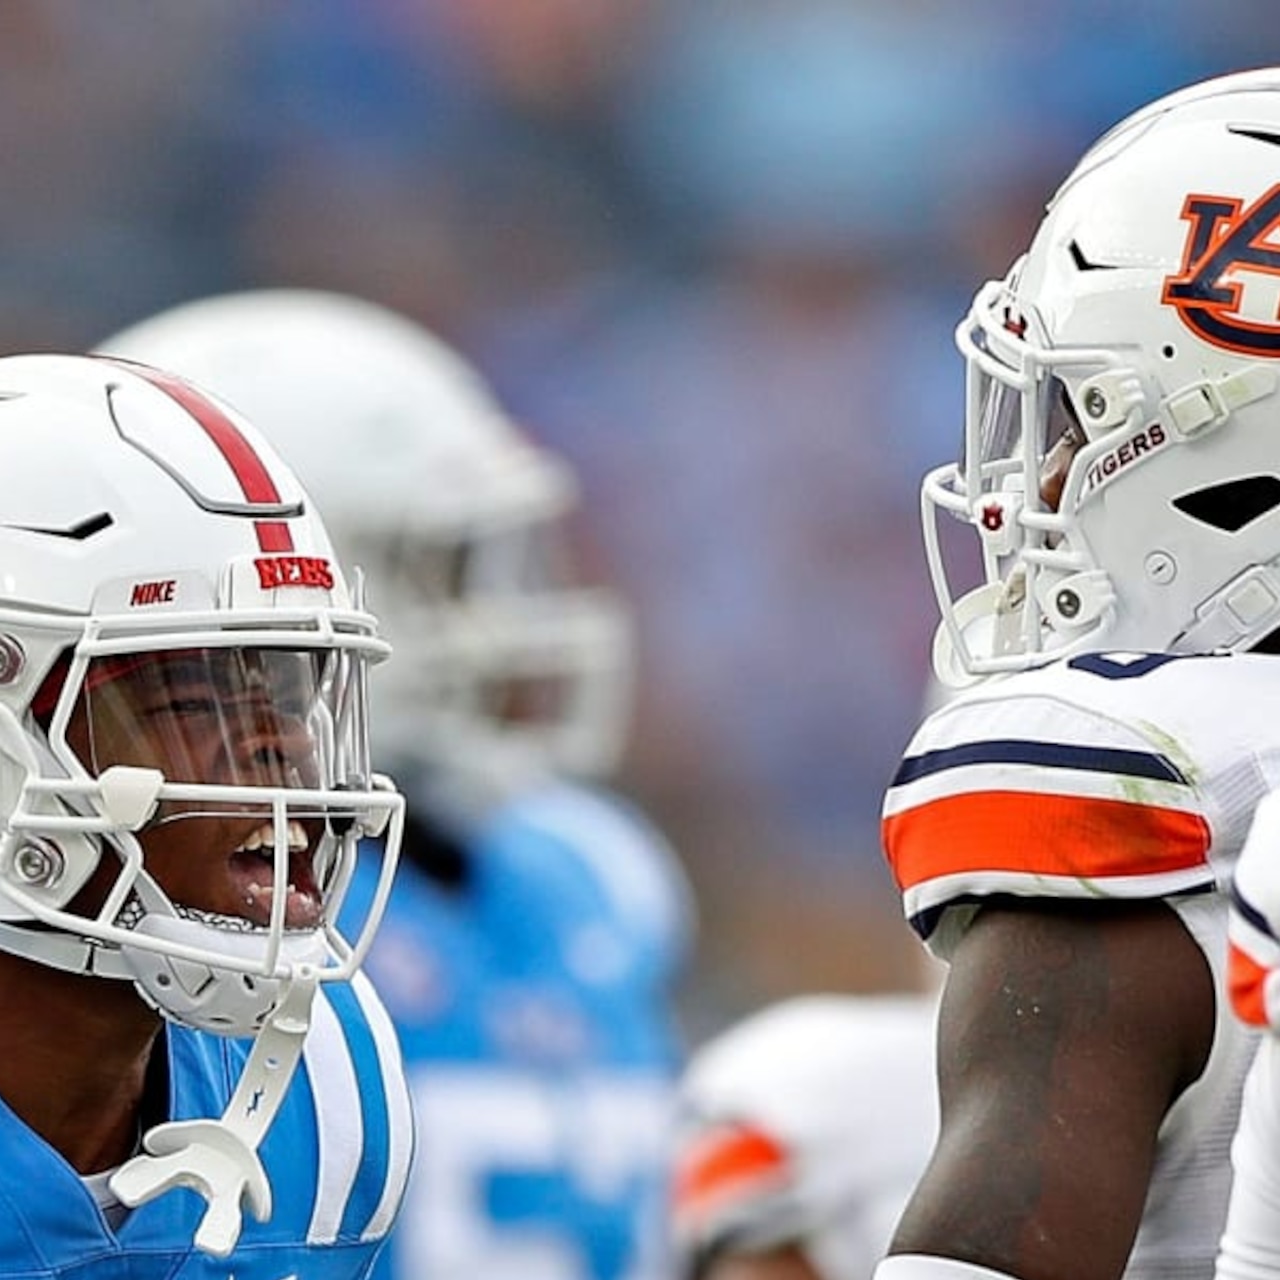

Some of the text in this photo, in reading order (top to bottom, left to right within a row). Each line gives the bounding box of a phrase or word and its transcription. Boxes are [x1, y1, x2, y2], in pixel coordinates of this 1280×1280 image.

[1088, 423, 1166, 492] TIGERS
[254, 557, 334, 590] REBS
[130, 580, 176, 606] NIKE
